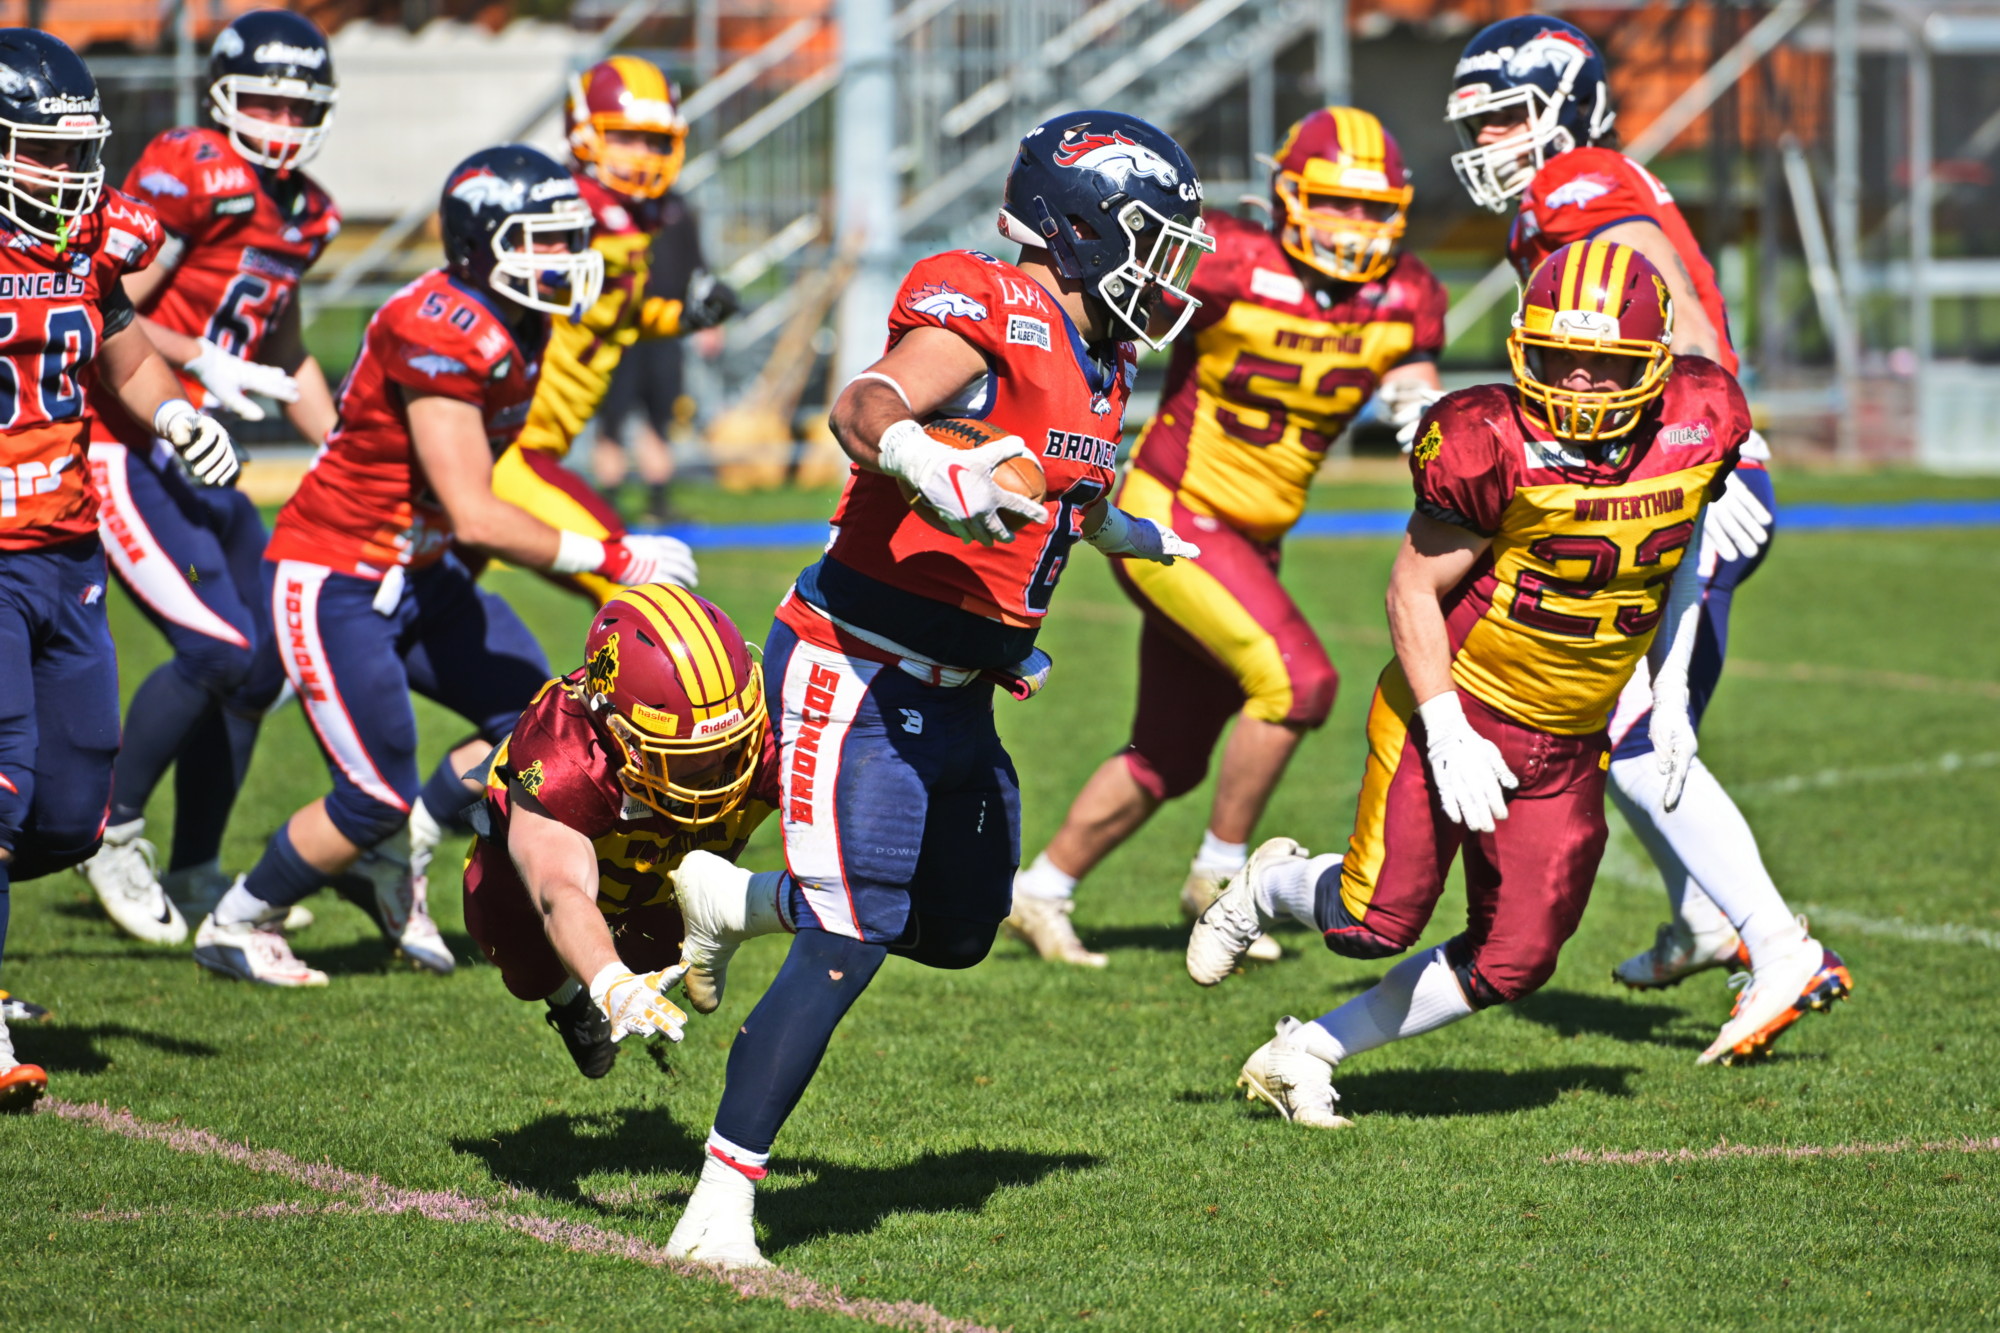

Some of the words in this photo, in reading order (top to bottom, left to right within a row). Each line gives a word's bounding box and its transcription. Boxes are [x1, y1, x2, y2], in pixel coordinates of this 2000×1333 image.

[106, 203, 158, 241] LAAX
[0, 272, 85, 298] ONCOS
[998, 278, 1050, 314] LAAX
[1574, 487, 1684, 522] WINTERTHUR
[637, 706, 673, 723] hasler
[700, 713, 739, 735] Riddell
[790, 661, 841, 826] BRONCOS
